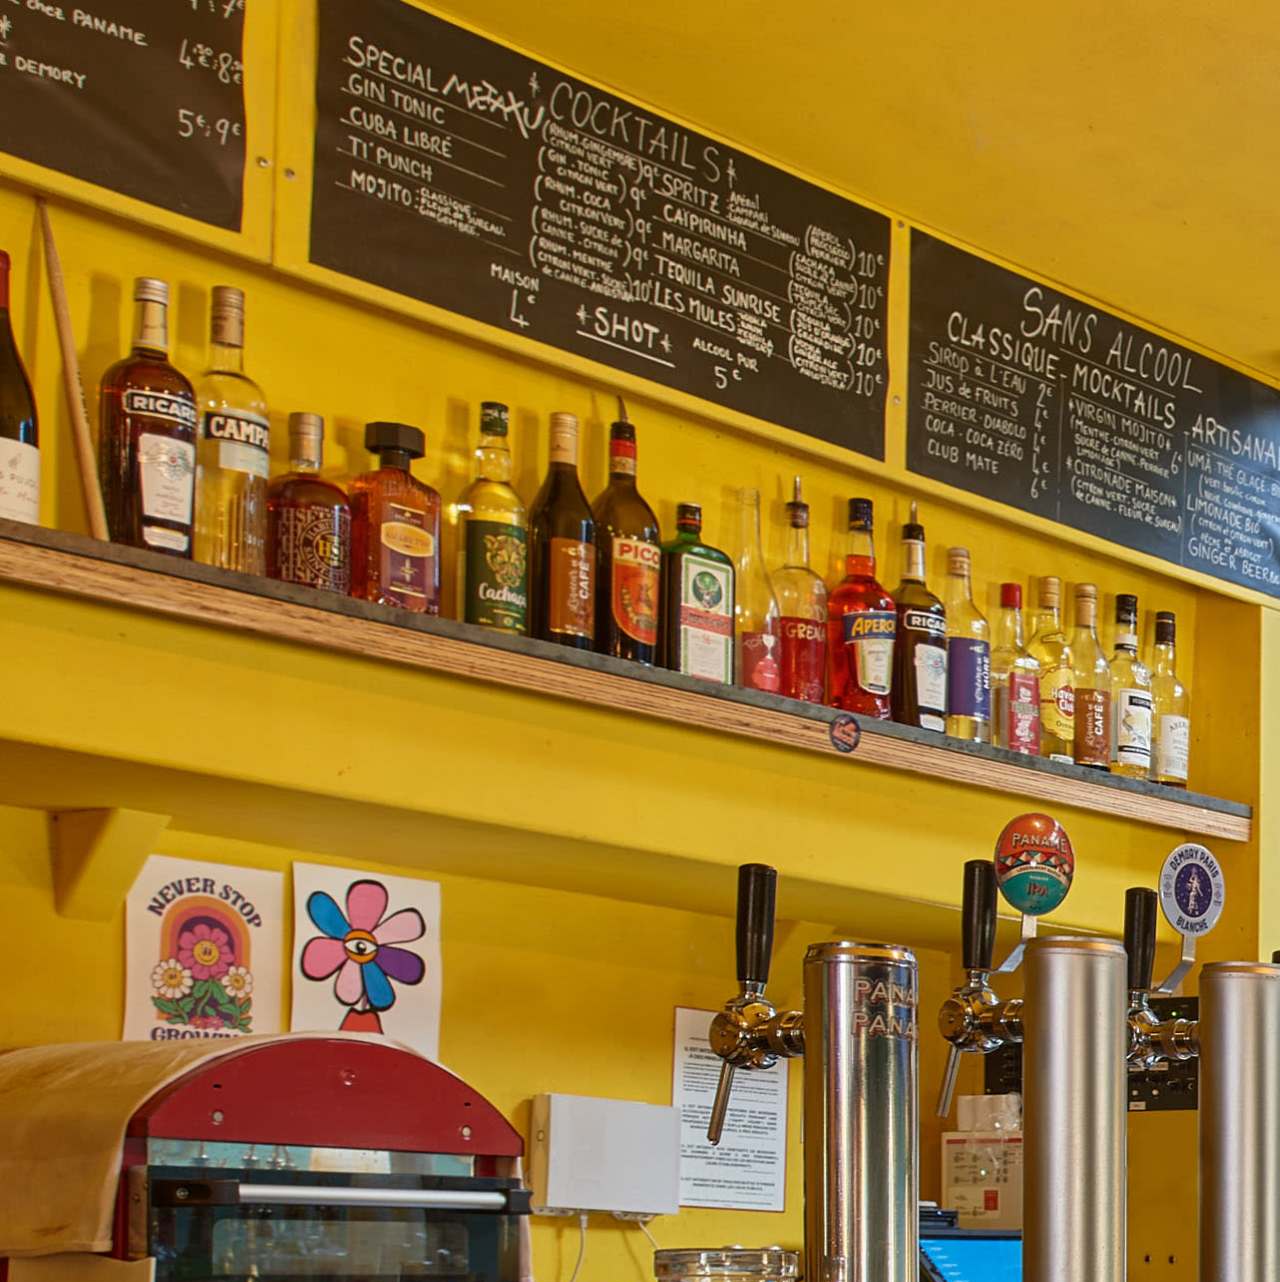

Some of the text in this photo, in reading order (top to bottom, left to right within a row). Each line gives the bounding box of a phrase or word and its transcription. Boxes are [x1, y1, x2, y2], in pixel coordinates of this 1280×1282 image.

[72, 9, 148, 46] PANAME
[15, 55, 87, 89] DEMORY
[346, 36, 439, 93] SPECIAL
[348, 73, 445, 124] GIN TONIC
[349, 106, 398, 140] CUBA
[550, 82, 721, 183] COCKTAILS
[375, 147, 433, 182] PUNCH
[576, 159, 610, 180] TONIC
[350, 170, 413, 207] MOJITO
[582, 191, 612, 211] COCA
[659, 173, 721, 215] SPRITZ
[660, 231, 741, 278] MARGARITA
[490, 262, 540, 293] MAISON
[655, 254, 716, 296] TEQUILA
[721, 284, 782, 323] SUNRISE
[594, 306, 661, 349] SHOT
[654, 281, 686, 313] LES
[688, 298, 737, 333] MULES
[692, 336, 735, 363] ALCOOL
[735, 351, 760, 374] PUR
[947, 311, 1060, 380] CLASSIQUE
[1020, 287, 1203, 394] SANS ALCOOL
[928, 341, 970, 381] SIROP
[990, 364, 1028, 395] L'EAU
[926, 368, 954, 393] JUS
[958, 382, 972, 400] de
[974, 387, 1019, 418] FRUITS
[1072, 363, 1176, 429] MOCKTAILS
[924, 391, 977, 423] PERRIER
[983, 414, 1027, 440] DIABOLO
[1075, 399, 1165, 449] VIRGIN MOJITO
[927, 438, 960, 464] CLUB
[965, 450, 999, 475] MATE
[965, 428, 994, 451] COCA
[1074, 460, 1132, 495] CITRONADE
[1186, 493, 1243, 531] LIMONADE
[1187, 537, 1238, 571] GINGER
[1241, 559, 1270, 583] BEER
[147, 877, 262, 927] NEVER STOP
